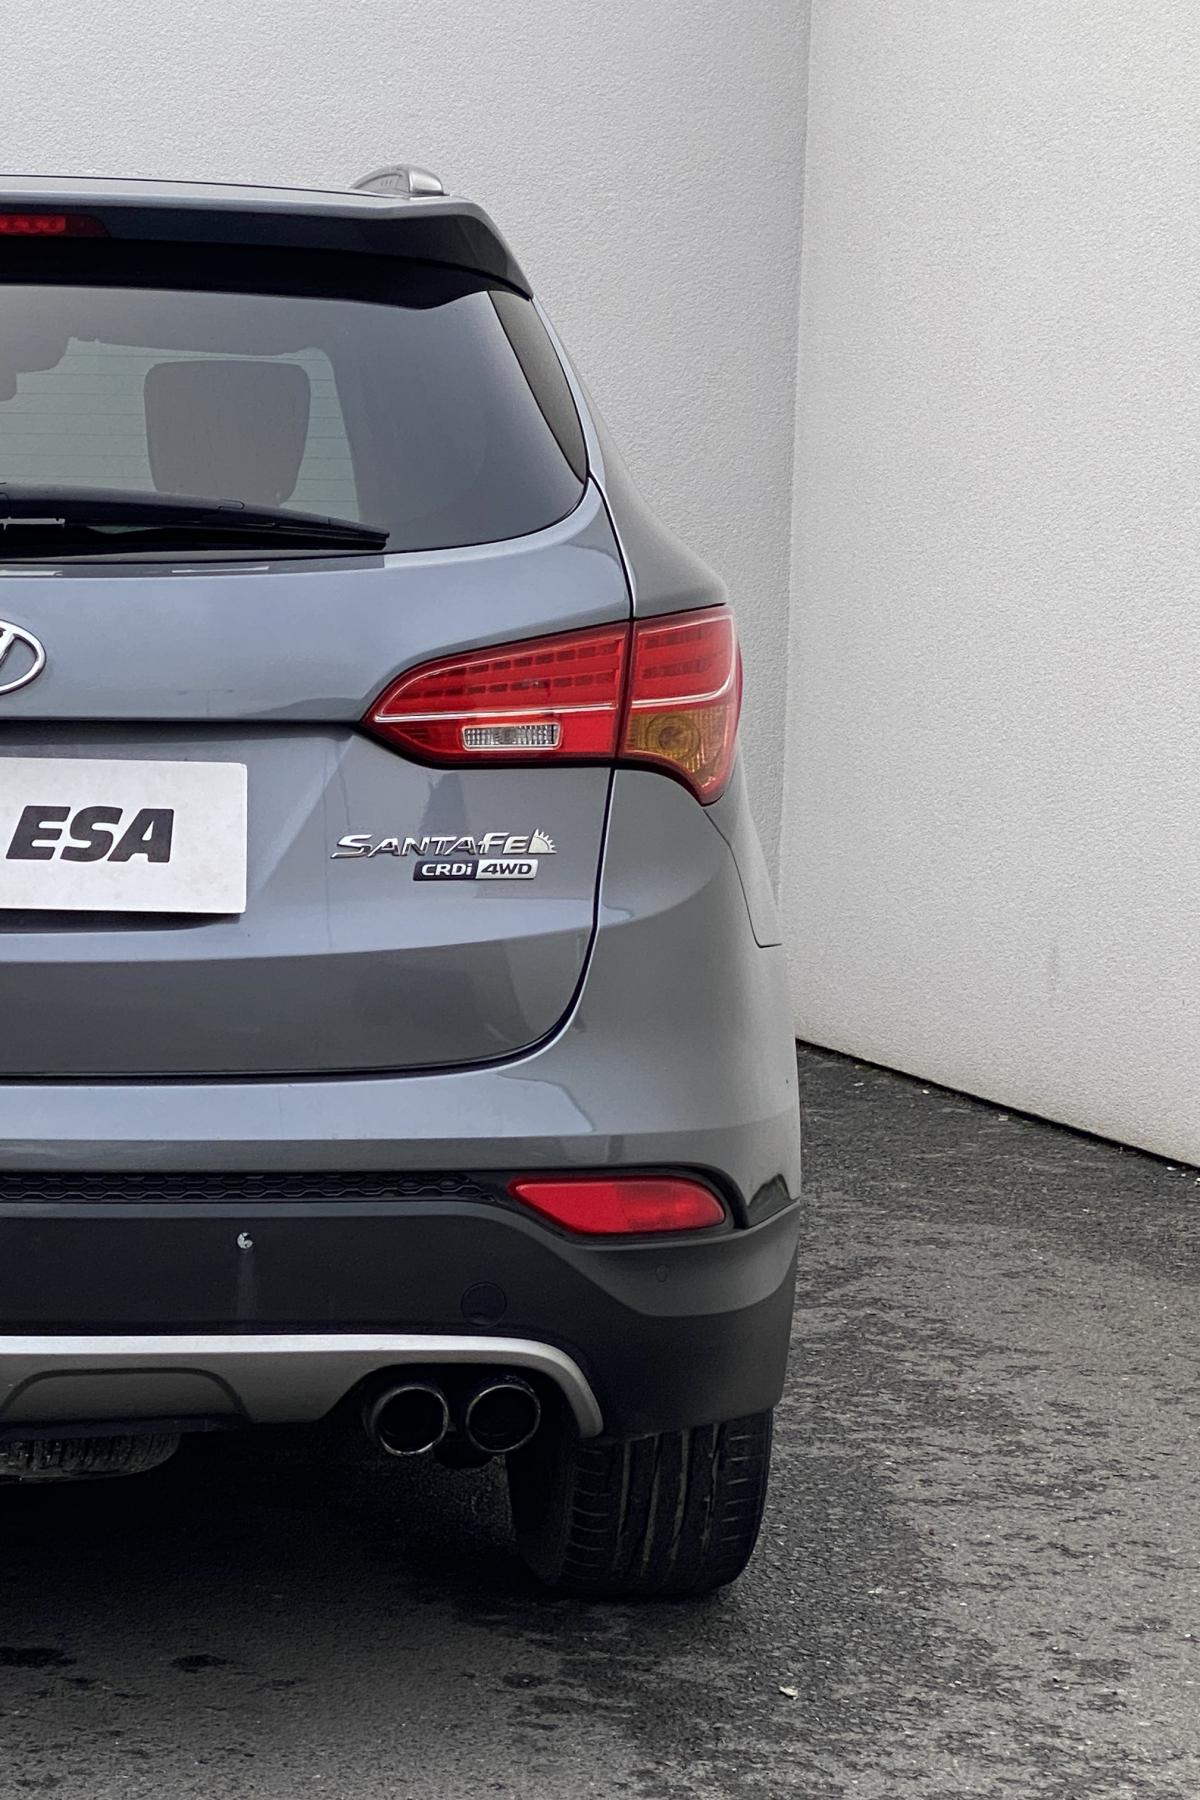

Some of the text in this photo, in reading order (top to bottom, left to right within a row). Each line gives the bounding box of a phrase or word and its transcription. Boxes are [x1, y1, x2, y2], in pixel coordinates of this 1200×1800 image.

[5, 805, 175, 863] ESA
[421, 863, 533, 876] CRDi 4WD
